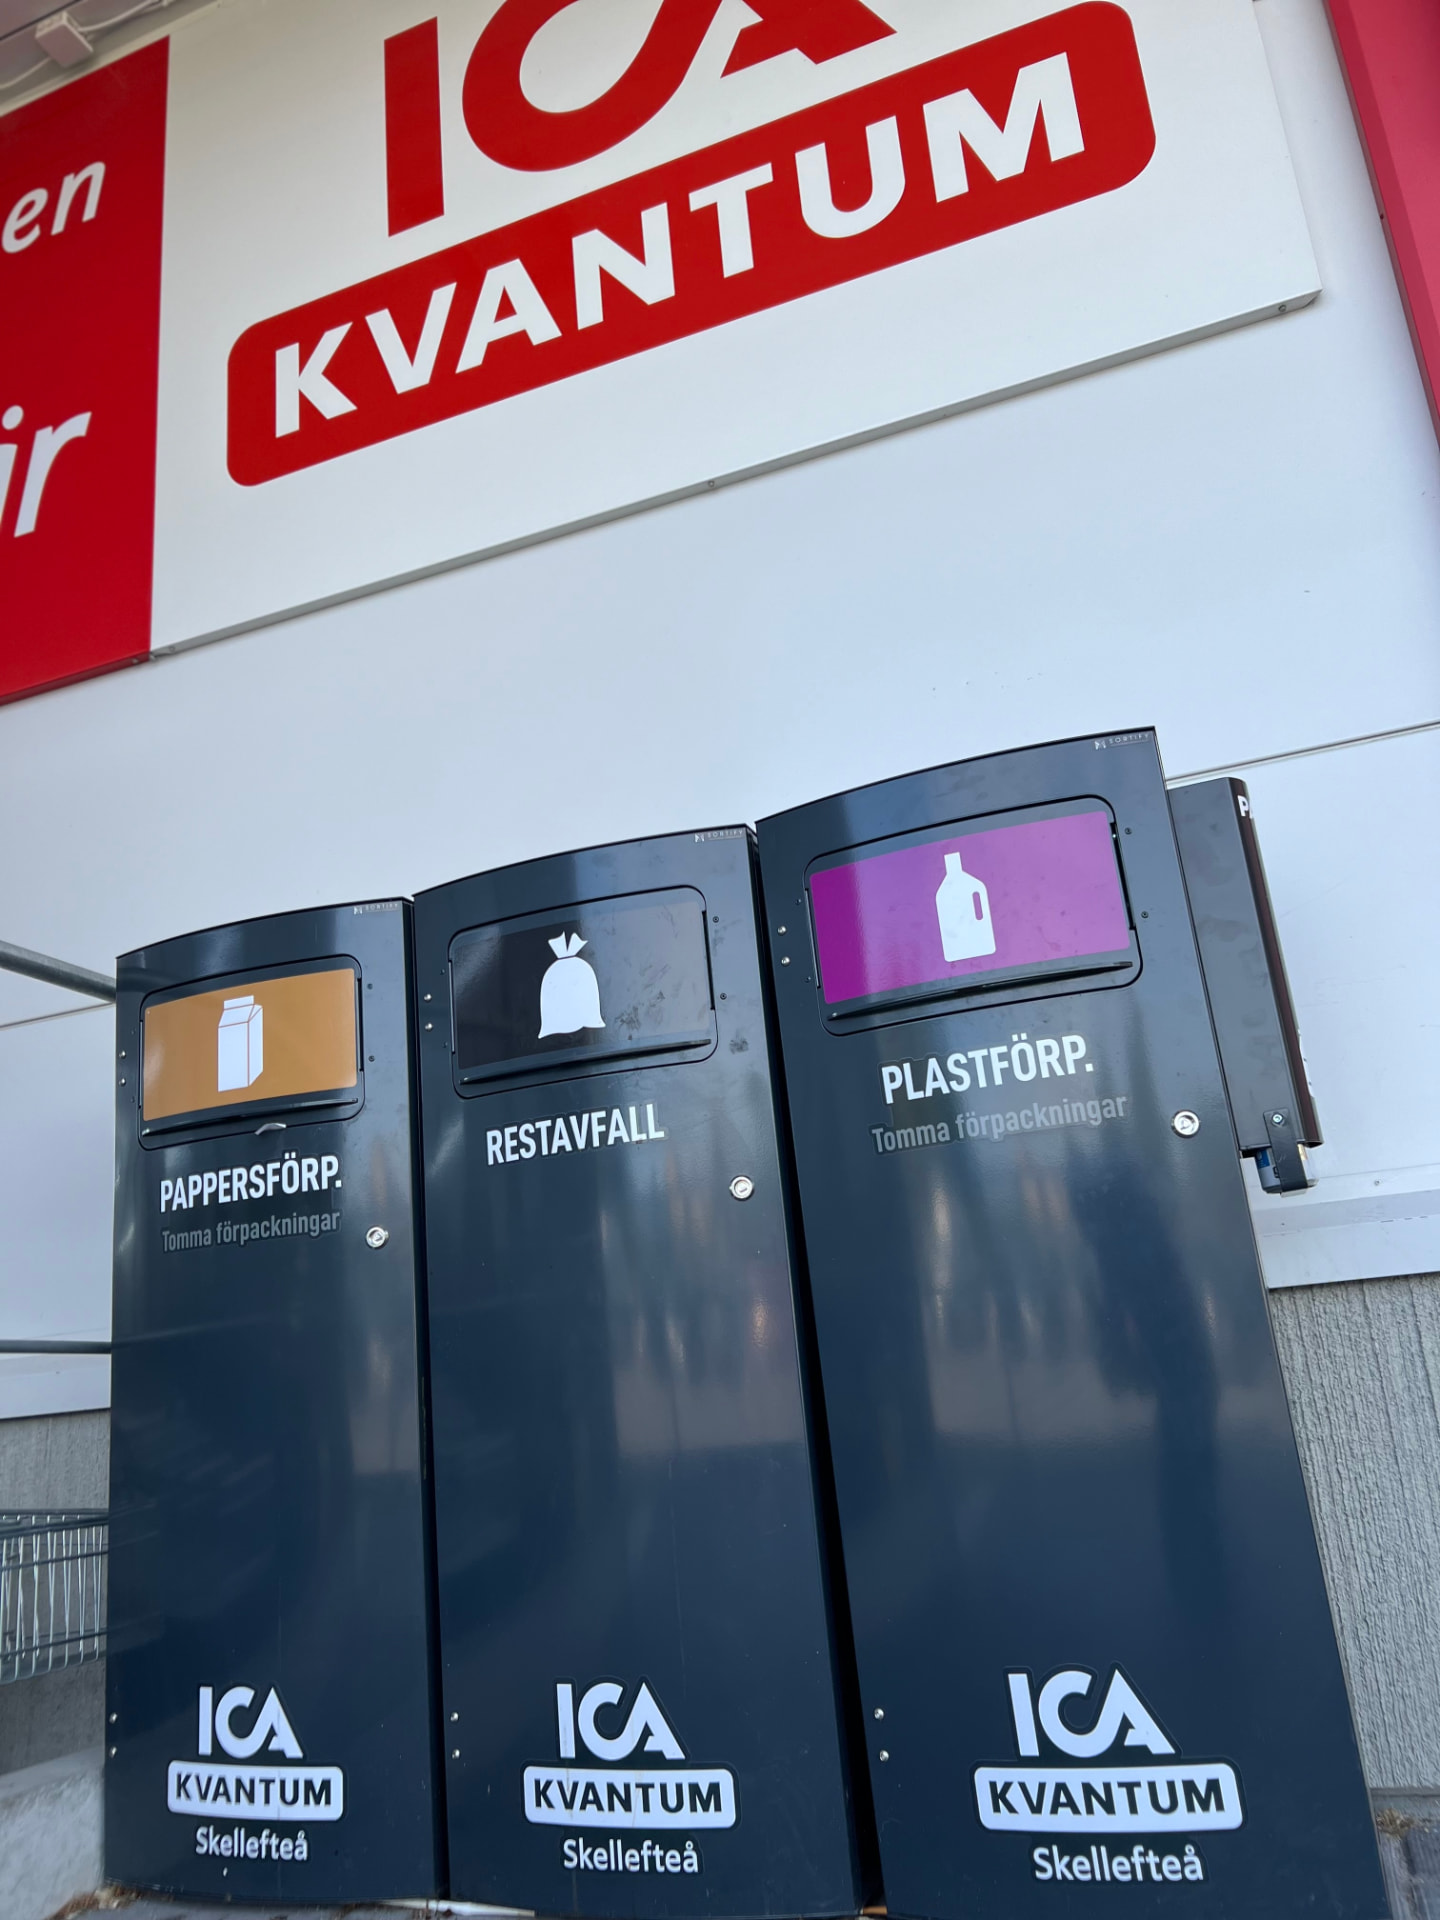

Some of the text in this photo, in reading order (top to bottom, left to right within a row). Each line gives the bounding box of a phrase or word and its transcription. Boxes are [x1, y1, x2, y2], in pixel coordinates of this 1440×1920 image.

[275, 51, 1085, 439] KVANTUM
[881, 1033, 1094, 1105] PLASTFÖRP.
[486, 1104, 665, 1166] RESTAVFALL
[872, 1096, 1127, 1154] Tomma förpackningar
[160, 1152, 342, 1213] PAPPERSFÖRP.
[162, 1210, 341, 1252] Tomma förpackningar
[198, 1686, 303, 1759] ICA
[556, 1682, 686, 1761] ICA
[1007, 1669, 1176, 1758] ICA
[175, 1772, 332, 1806] KVANTUM
[534, 1778, 722, 1814] KVANTUM
[989, 1778, 1225, 1816] KVANTUM
[195, 1827, 308, 1861] Skellefteå
[563, 1837, 699, 1874] Skellefteå
[1033, 1844, 1204, 1882] Skellefteå
